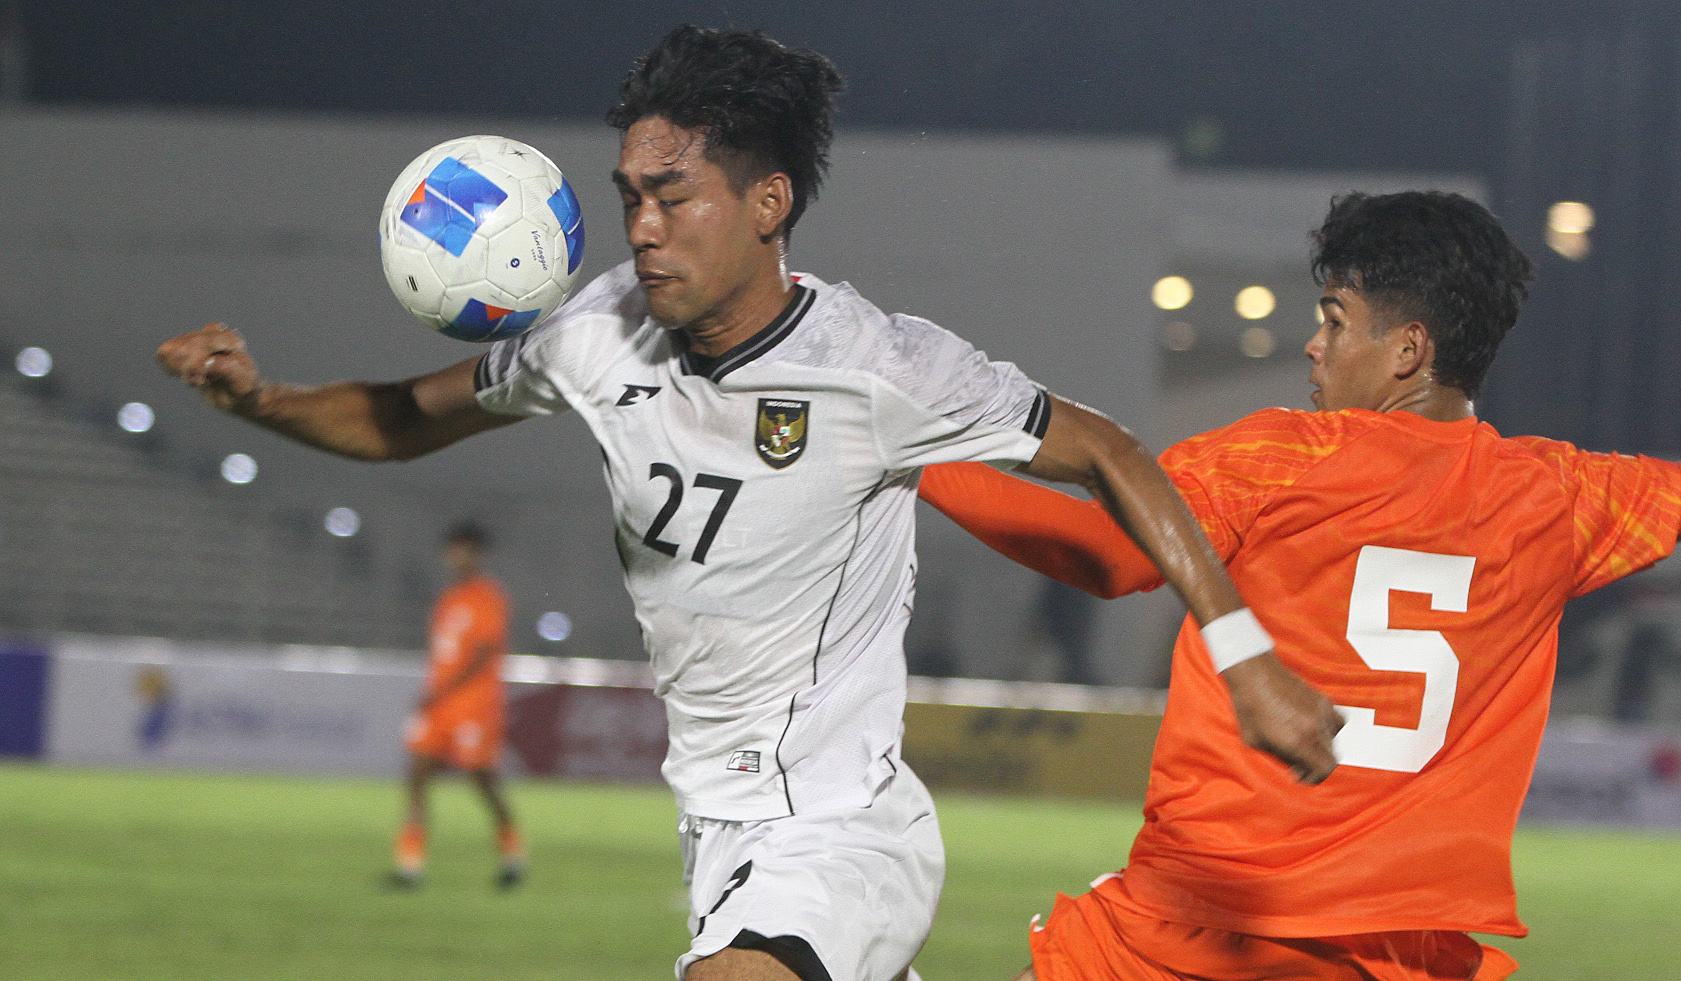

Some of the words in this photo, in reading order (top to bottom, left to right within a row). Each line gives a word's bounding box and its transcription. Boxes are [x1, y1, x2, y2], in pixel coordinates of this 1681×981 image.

[531, 230, 548, 271] Vantaggio
[643, 462, 743, 565] 27
[1332, 545, 1477, 773] 5
